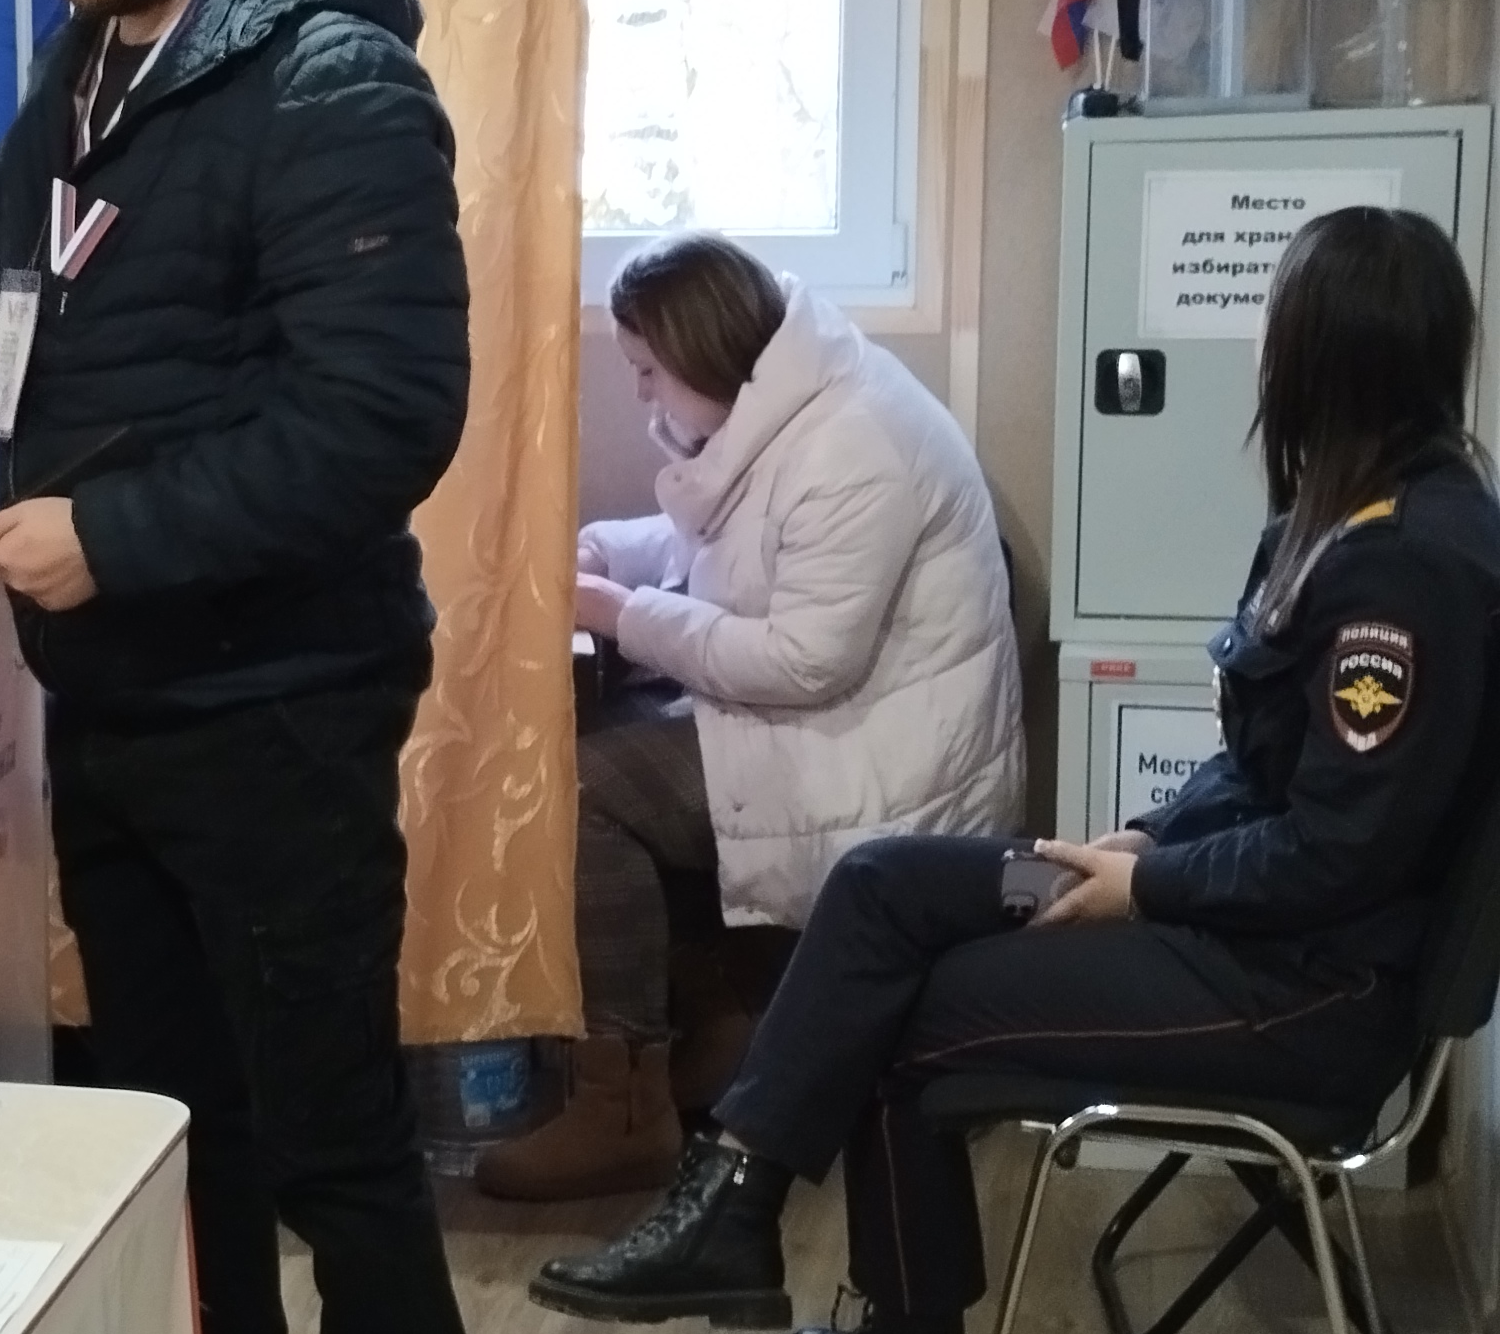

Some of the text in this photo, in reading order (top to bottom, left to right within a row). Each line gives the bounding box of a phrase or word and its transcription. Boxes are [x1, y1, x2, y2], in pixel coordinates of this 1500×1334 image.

[1231, 194, 1306, 210] Место
[1182, 231, 1225, 246] для
[1176, 292, 1265, 309] докуме
[1341, 626, 1408, 648] ПОЛИЦИЯ
[1340, 653, 1403, 680] РОССИЯ
